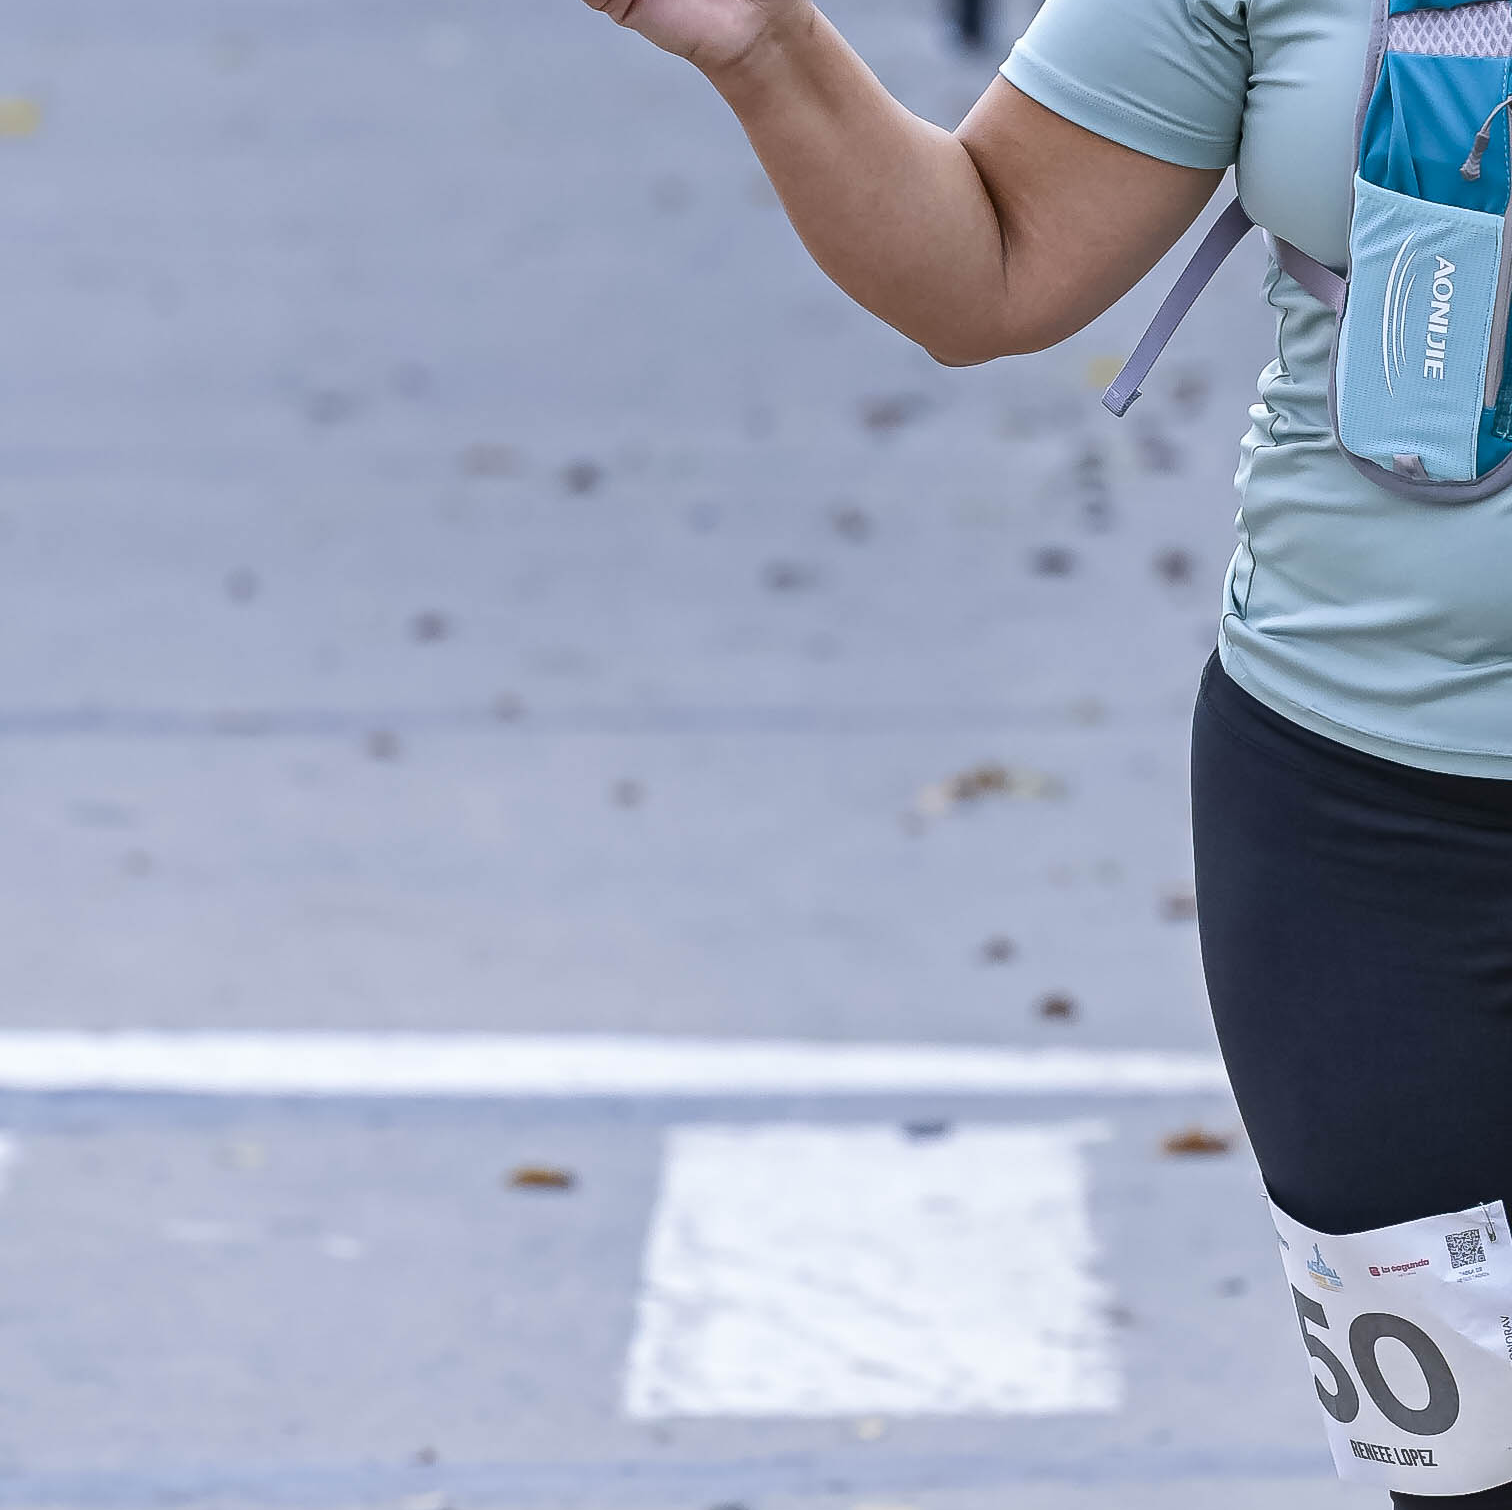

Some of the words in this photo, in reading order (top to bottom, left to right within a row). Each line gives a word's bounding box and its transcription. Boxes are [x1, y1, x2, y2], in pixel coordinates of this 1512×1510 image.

[1423, 255, 1456, 380] AONIJIE
[1291, 1282, 1460, 1437] 50
[1394, 1447, 1439, 1467] LOPEZ
